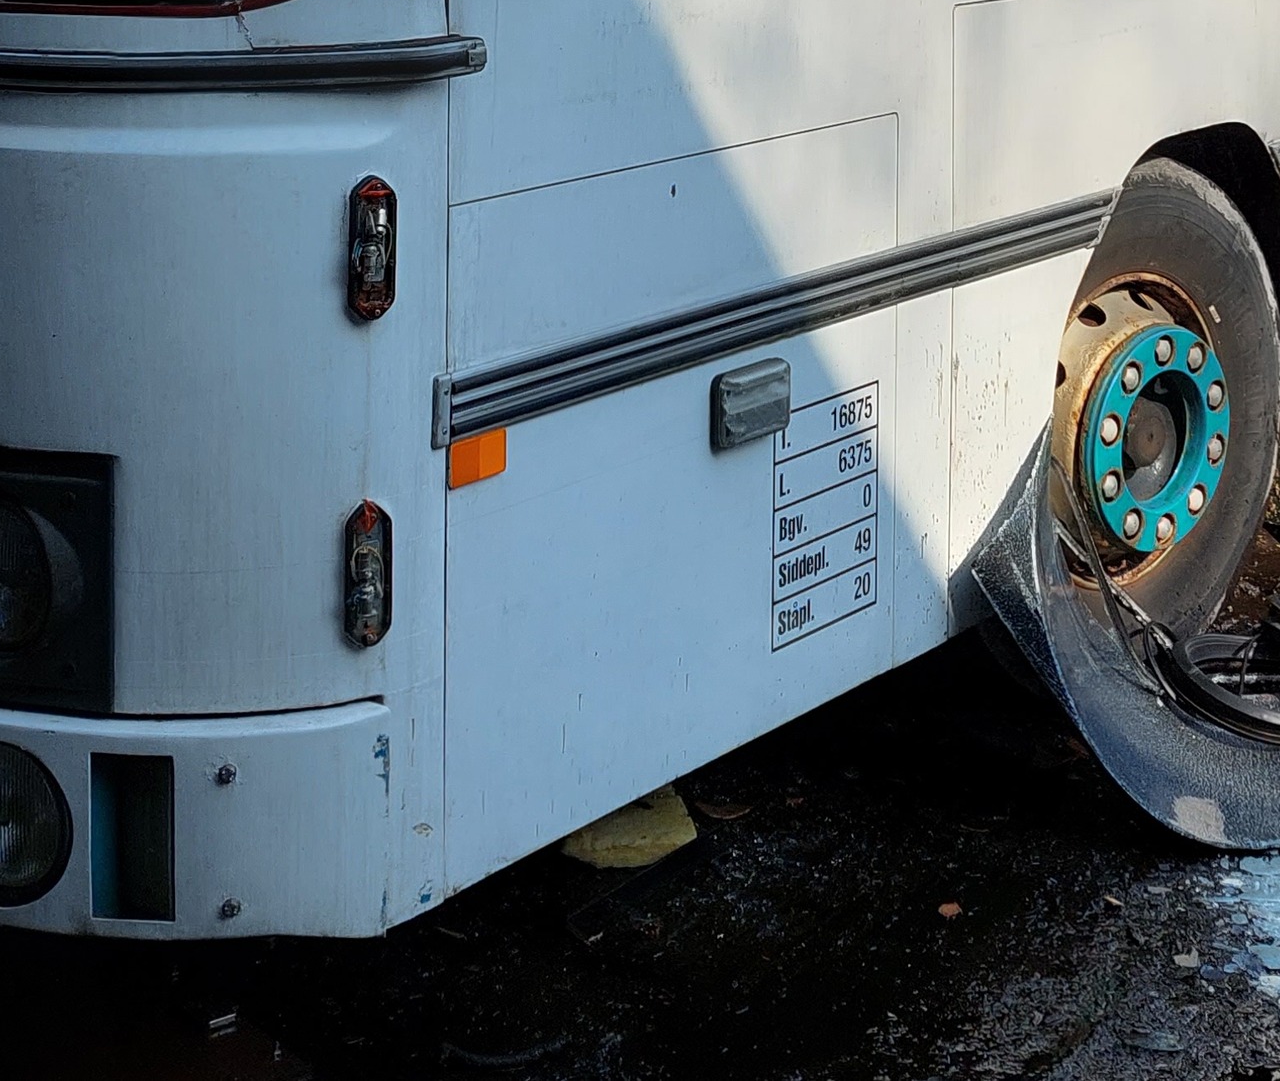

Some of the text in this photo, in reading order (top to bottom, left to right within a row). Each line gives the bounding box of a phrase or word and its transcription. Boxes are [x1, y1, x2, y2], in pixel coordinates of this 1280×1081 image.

[830, 394, 873, 431] 16875
[779, 438, 873, 498] L. 6375
[778, 483, 872, 542] Bgv. 0
[778, 527, 872, 588] Siddepl. 49
[777, 571, 871, 636] Ståpl. 20
